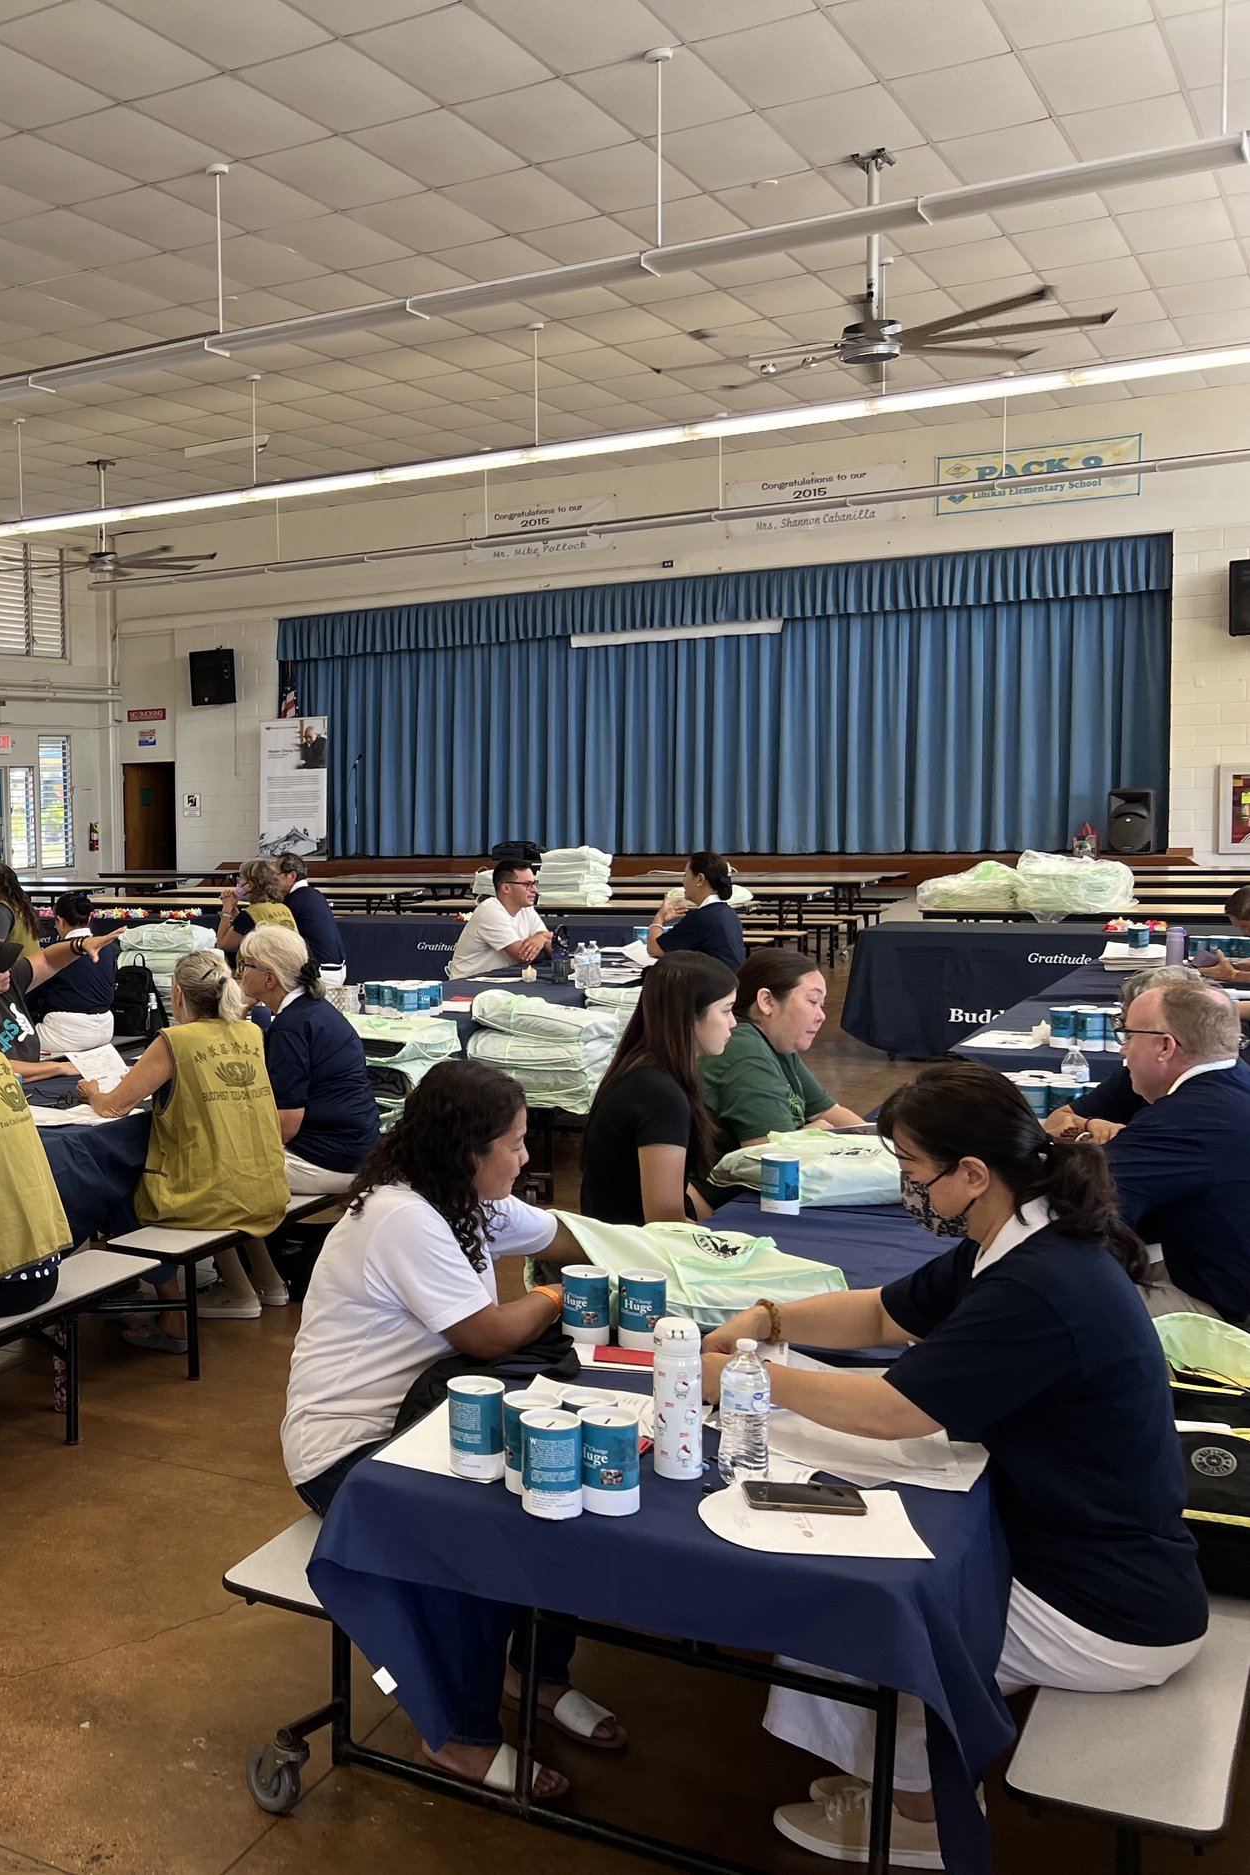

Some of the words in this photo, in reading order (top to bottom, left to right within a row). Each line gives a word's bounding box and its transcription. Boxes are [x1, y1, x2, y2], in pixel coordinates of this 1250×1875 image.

[975, 456, 1070, 481] PACK
[761, 475, 834, 491] Congratulations
[837, 473, 847, 481] to
[850, 471, 867, 480] our
[1009, 483, 1065, 497] Elementary
[1068, 478, 1101, 489] School
[792, 487, 827, 499] 2015
[494, 508, 555, 521] Congratulations
[756, 521, 777, 531] Mrs.
[780, 514, 821, 529] Shannon
[823, 509, 876, 525] Cabanilla
[520, 518, 550, 528] 2015
[492, 551, 510, 559] Mr.
[514, 546, 539, 557] Mike
[543, 541, 587, 553] Pollock
[1028, 953, 1092, 965] Gratitude
[564, 1293, 588, 1309] Huge
[624, 1298, 652, 1314] Huge
